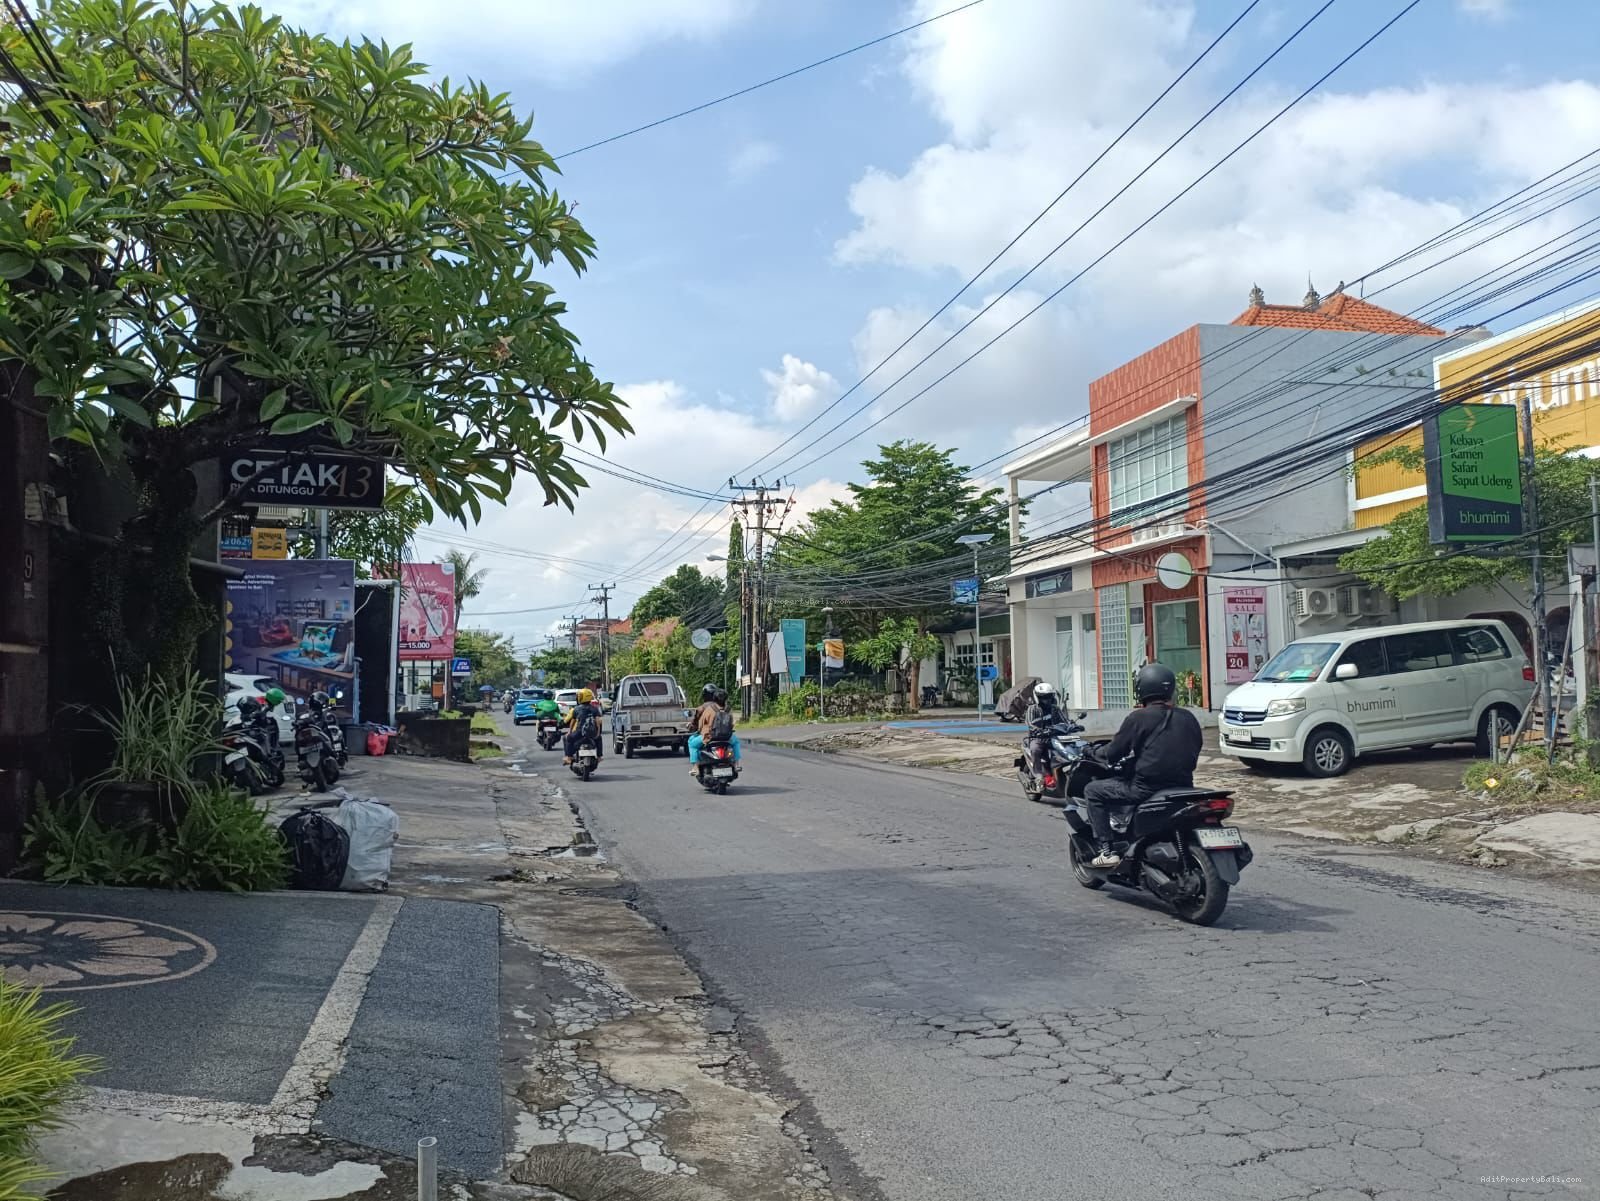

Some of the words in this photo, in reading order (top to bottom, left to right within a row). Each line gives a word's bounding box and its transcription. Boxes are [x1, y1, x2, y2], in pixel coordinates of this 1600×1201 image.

[1450, 434, 1484, 449] Kebaya
[1450, 448, 1484, 460] Kamen
[1452, 461, 1478, 473] Safari
[1452, 475, 1479, 489] Saput
[1481, 475, 1513, 490] Udeng
[257, 484, 315, 496] DITUNGGU
[1459, 510, 1510, 524] bhumimi
[1234, 604, 1257, 612] SALE
[1229, 657, 1244, 668] 20
[1347, 696, 1397, 713] bhumimi
